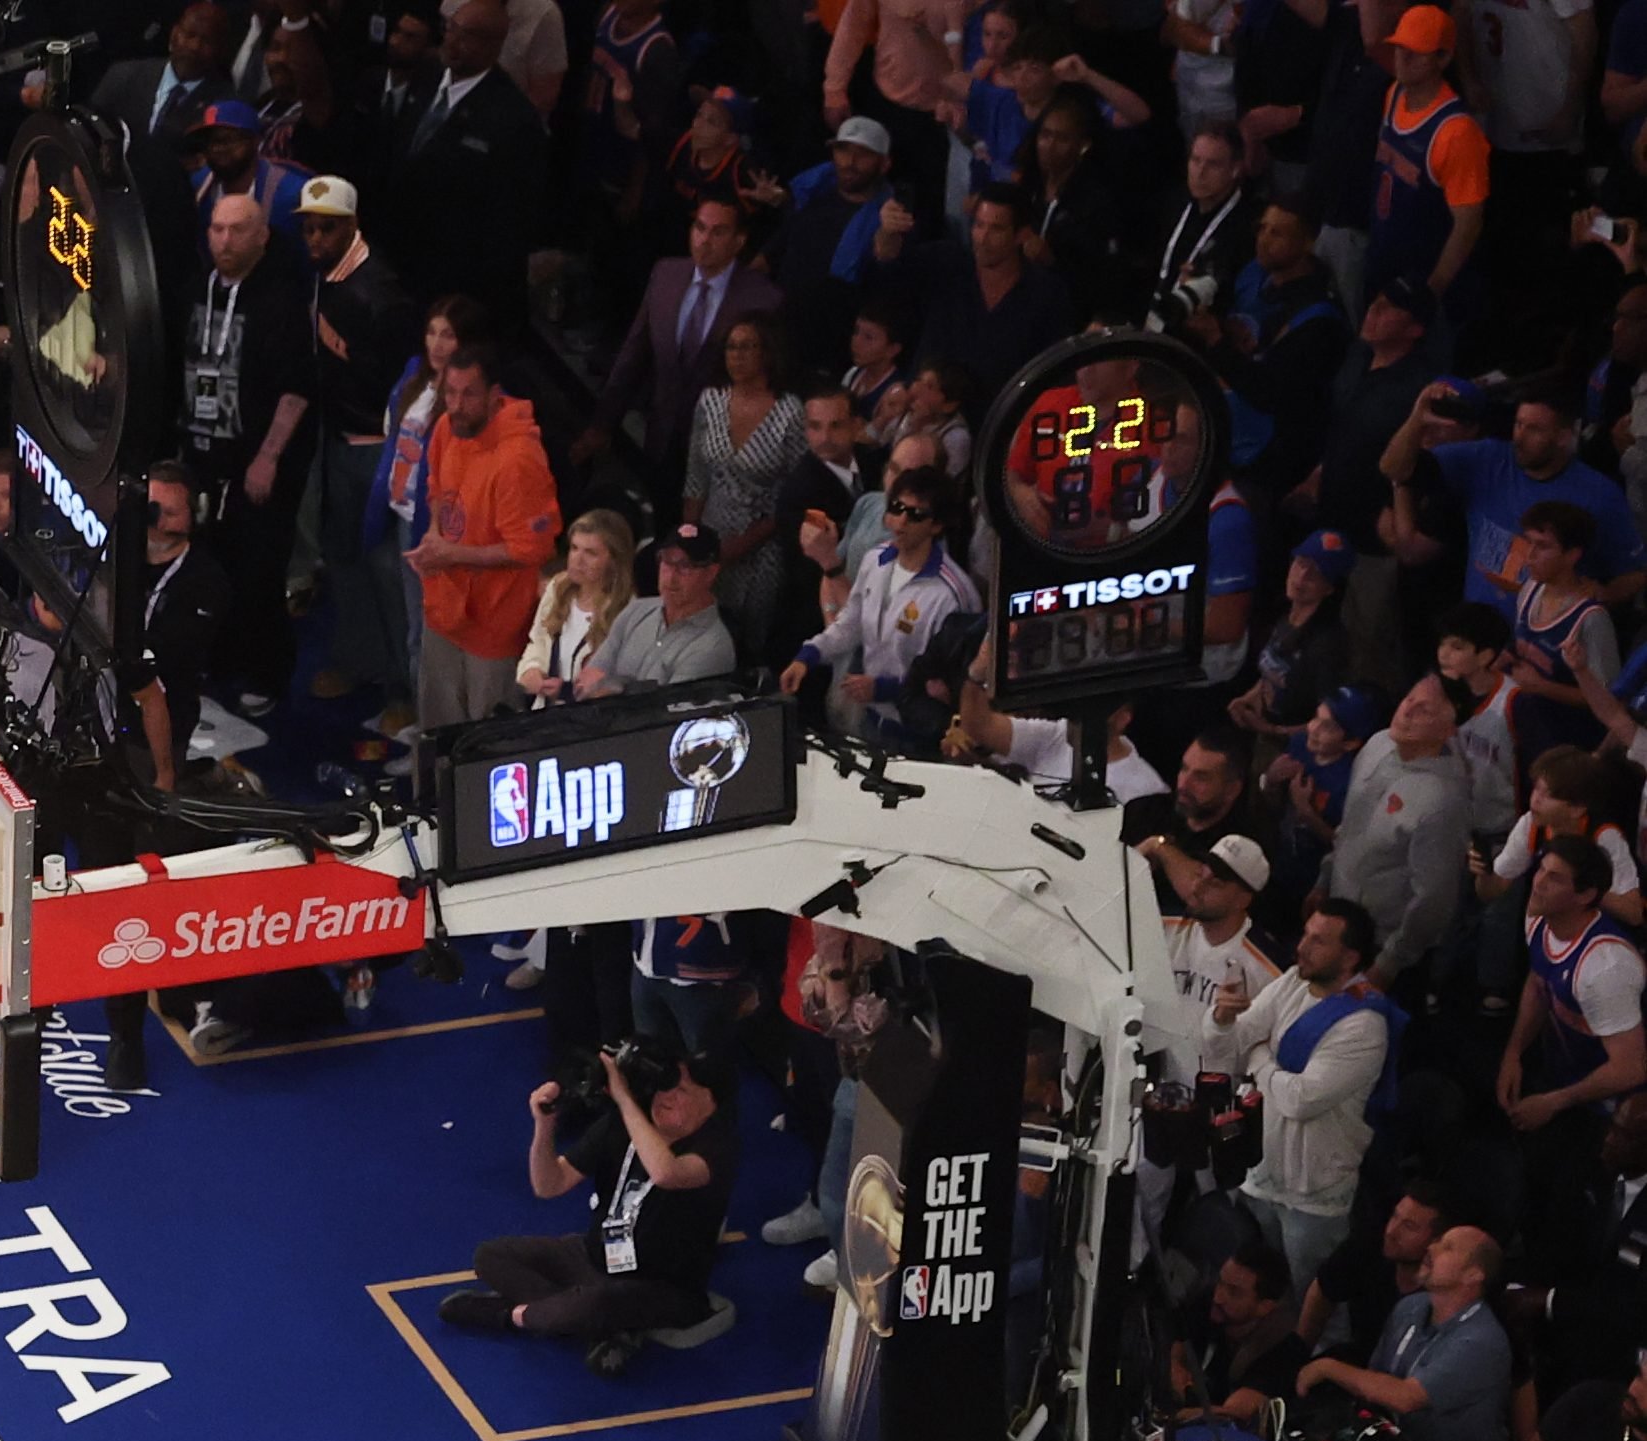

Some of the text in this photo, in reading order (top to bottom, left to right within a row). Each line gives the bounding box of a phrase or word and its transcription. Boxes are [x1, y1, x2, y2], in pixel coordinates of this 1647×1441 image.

[1062, 397, 1144, 458] 2.2
[1062, 564, 1197, 609] TISSOT
[533, 757, 625, 848] App
[925, 1152, 991, 1208] GET
[922, 1206, 987, 1260] THE
[929, 1264, 995, 1325] App
